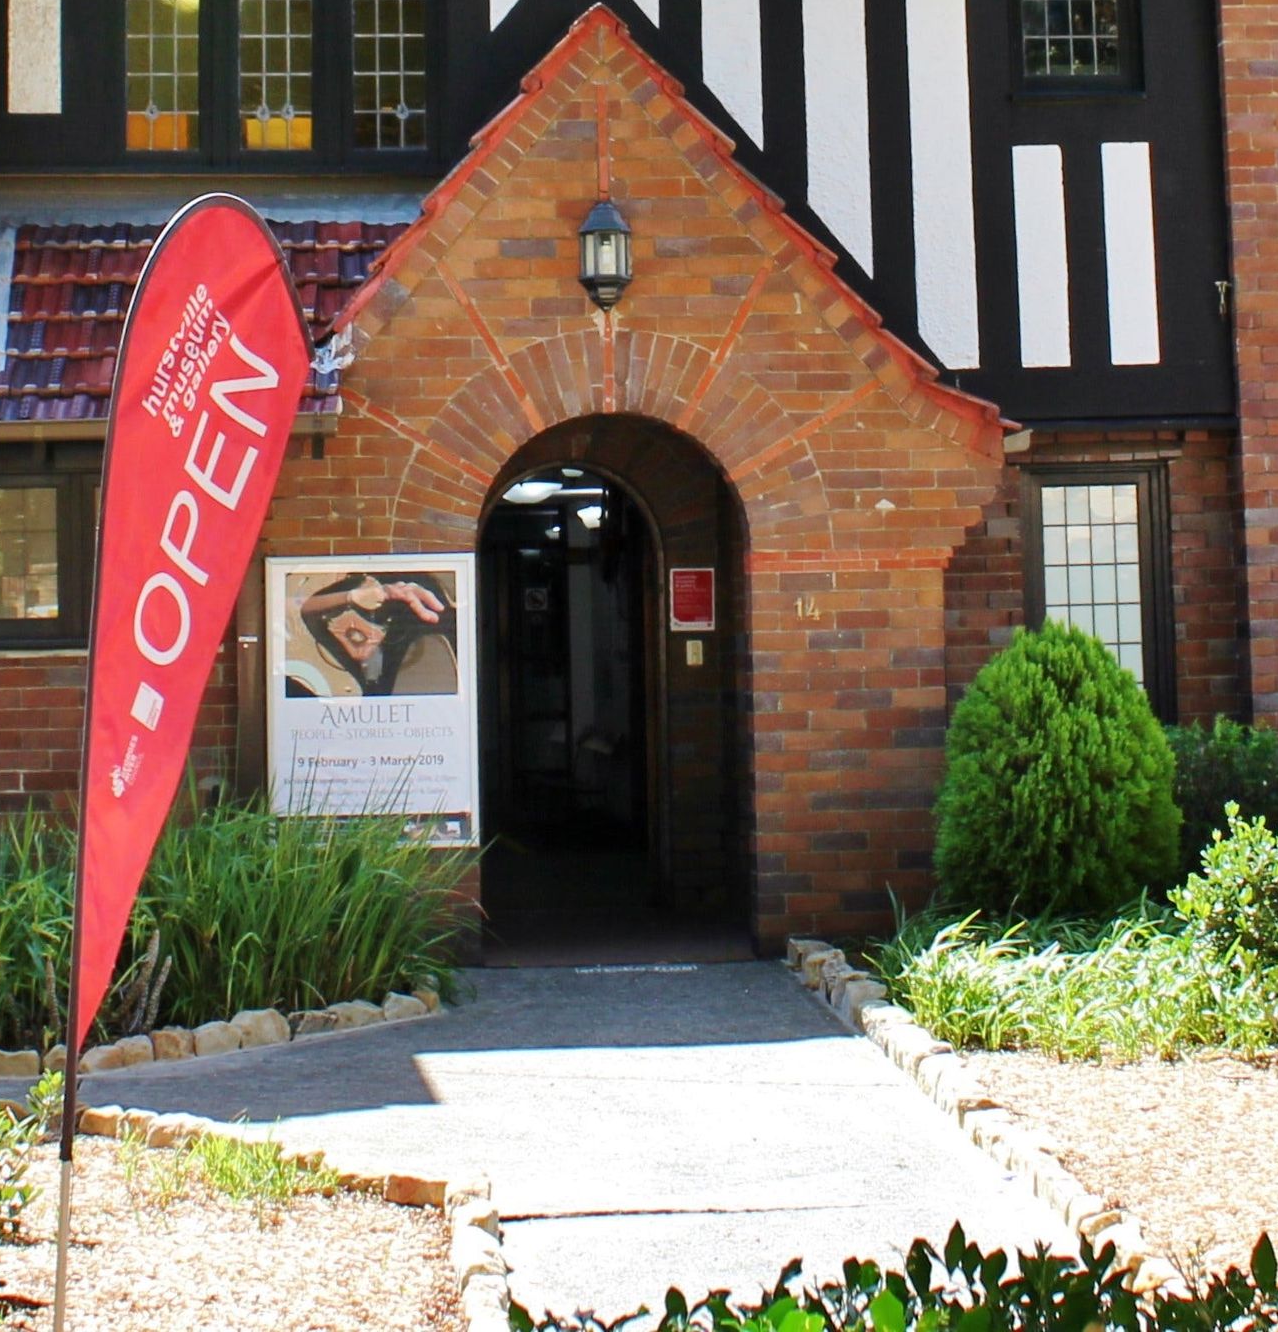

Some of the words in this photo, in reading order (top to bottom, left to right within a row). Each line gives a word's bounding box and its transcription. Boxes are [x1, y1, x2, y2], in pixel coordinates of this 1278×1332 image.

[141, 283, 208, 418] hurstville
[161, 298, 214, 424] museum
[168, 413, 185, 438] &
[183, 310, 231, 412] gallery
[133, 333, 280, 666] OPEN
[794, 597, 821, 621] 14
[297, 756, 305, 768] 9
[308, 755, 358, 769] February
[369, 755, 377, 767] 3
[380, 754, 416, 767] March
[418, 753, 445, 766] 2019
[346, 727, 395, 740] STORIES
[403, 726, 455, 739] OBJECTS
